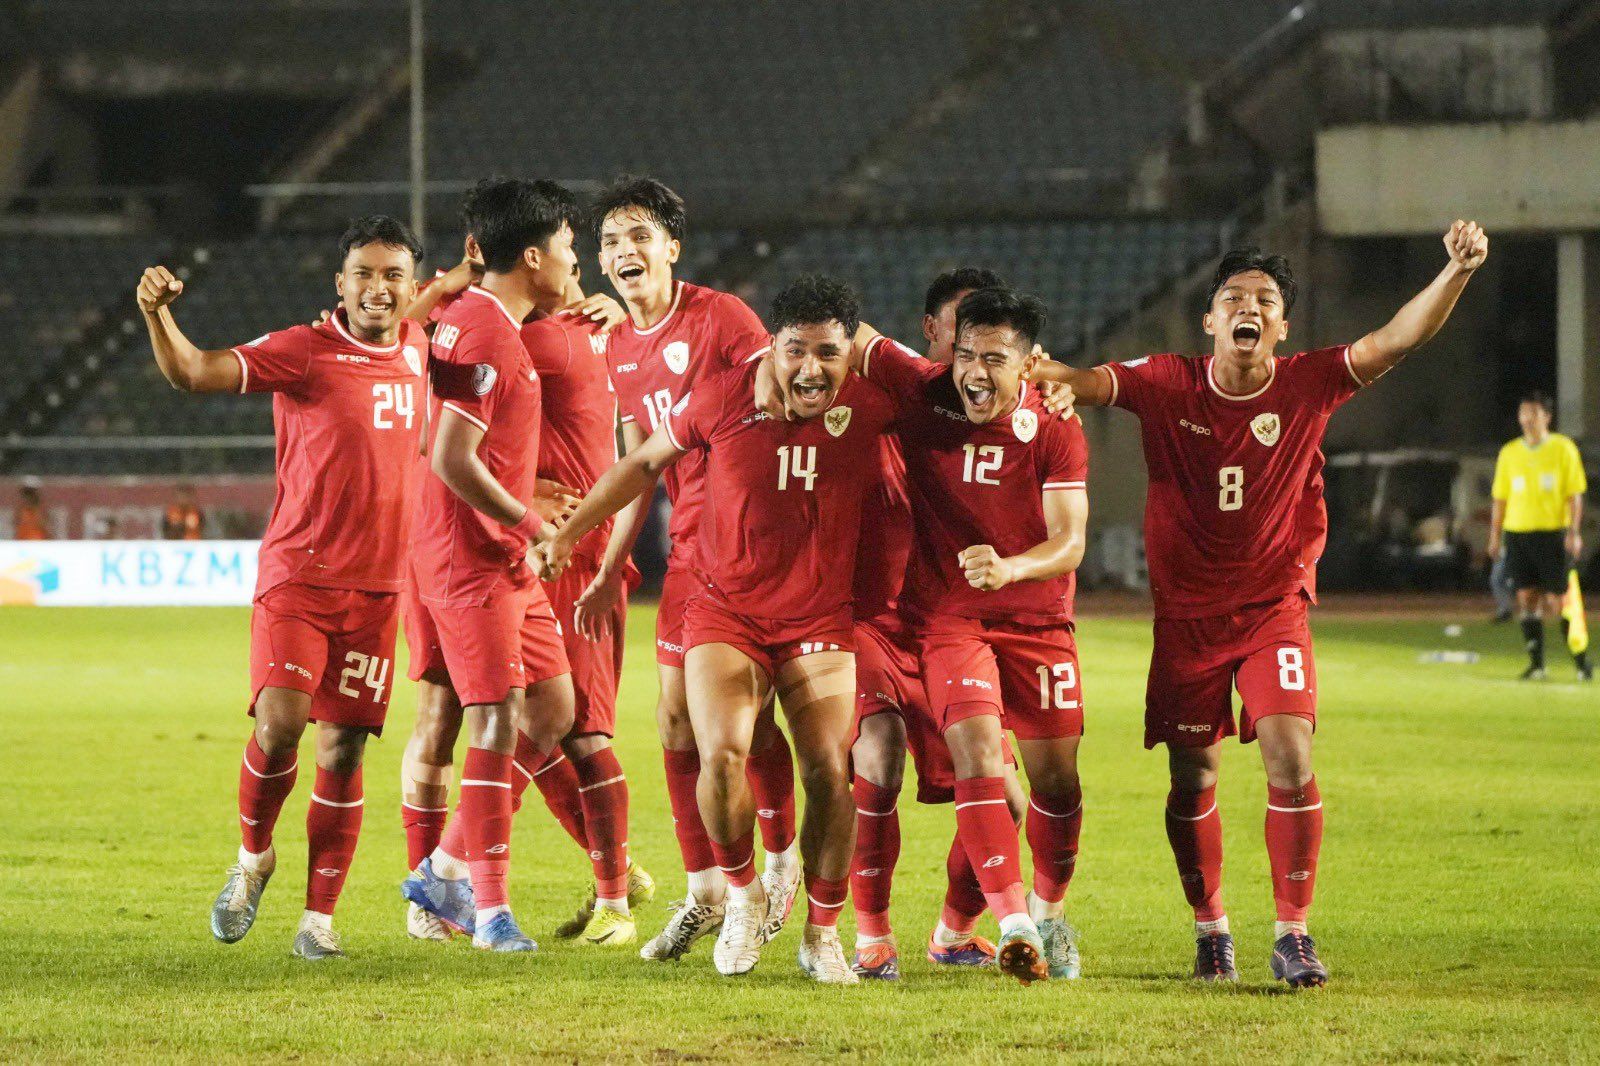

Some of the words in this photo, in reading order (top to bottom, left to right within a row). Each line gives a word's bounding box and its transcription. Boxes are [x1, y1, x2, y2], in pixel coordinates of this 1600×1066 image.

[336, 354, 370, 364] erspo
[372, 383, 415, 429] 24
[643, 388, 672, 431] 18
[933, 405, 967, 422] erspo
[1179, 418, 1211, 436] erspo
[777, 445, 818, 491] 14
[962, 443, 1005, 486] 12
[1218, 465, 1244, 512] 8
[101, 550, 259, 588] KBZM
[338, 650, 389, 703] 24
[962, 678, 993, 690] erspo
[1035, 662, 1078, 710] 12
[1276, 647, 1305, 691] 8
[1177, 722, 1213, 734] erspo
